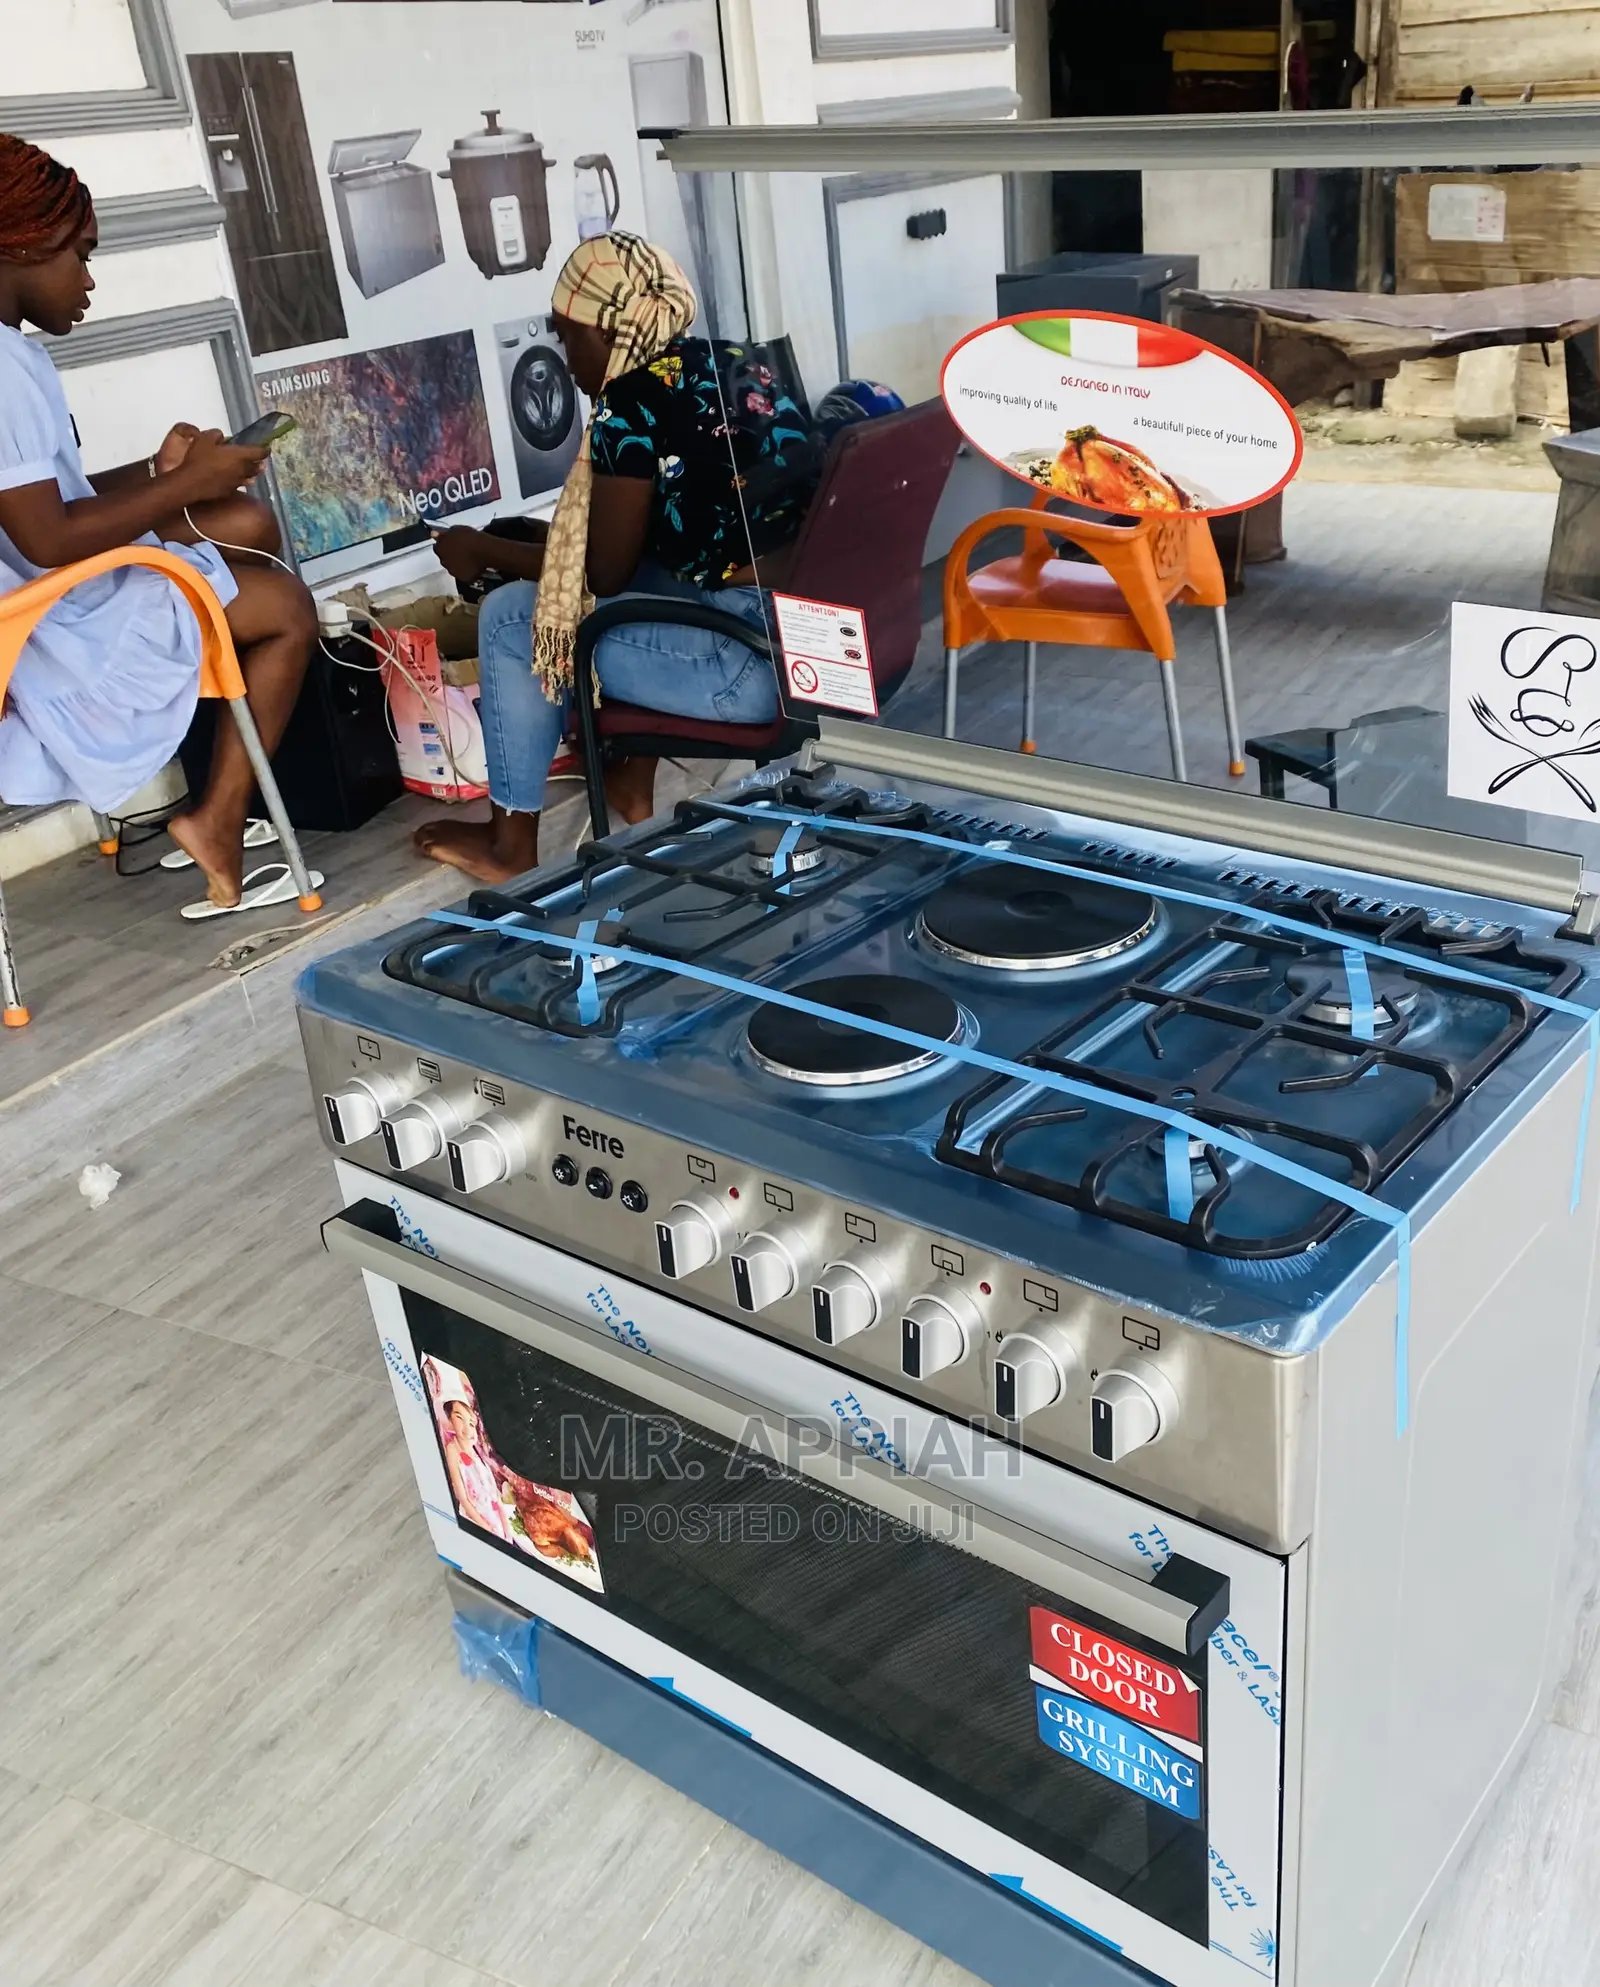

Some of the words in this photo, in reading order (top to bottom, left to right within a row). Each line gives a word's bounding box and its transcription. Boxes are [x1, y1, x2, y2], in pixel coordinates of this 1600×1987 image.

[262, 369, 331, 398] SAMSUNG
[959, 384, 1001, 404] improving
[1003, 393, 1031, 410] quality
[1034, 399, 1043, 409] of
[1044, 400, 1058, 412] life
[1061, 376, 1109, 392] DESIGNED
[1112, 383, 1122, 395] IN
[1125, 386, 1151, 399] ITALY
[1133, 417, 1139, 426] a
[1141, 416, 1184, 433] beautifull
[1186, 424, 1212, 438] piece
[1214, 430, 1224, 440] of
[1226, 433, 1248, 444] your
[1250, 435, 1278, 449] home
[399, 489, 441, 517] Neo
[444, 467, 493, 502] QLED
[798, 604, 840, 617] ATTENTION!
[562, 1114, 625, 1159] Ferre
[390, 1195, 411, 1226] The
[586, 1292, 605, 1313] for
[597, 1283, 620, 1316] The
[830, 1399, 852, 1423] for
[844, 1390, 871, 1428] The
[1128, 1532, 1154, 1558] for
[1050, 1622, 1177, 1696] CLOSED
[1069, 1656, 1161, 1718] DOOR
[1042, 1697, 1195, 1788] GRILLING
[1058, 1730, 1181, 1808] SYSTEM
[1211, 1876, 1239, 1912] The
[1233, 1884, 1257, 1908] for
